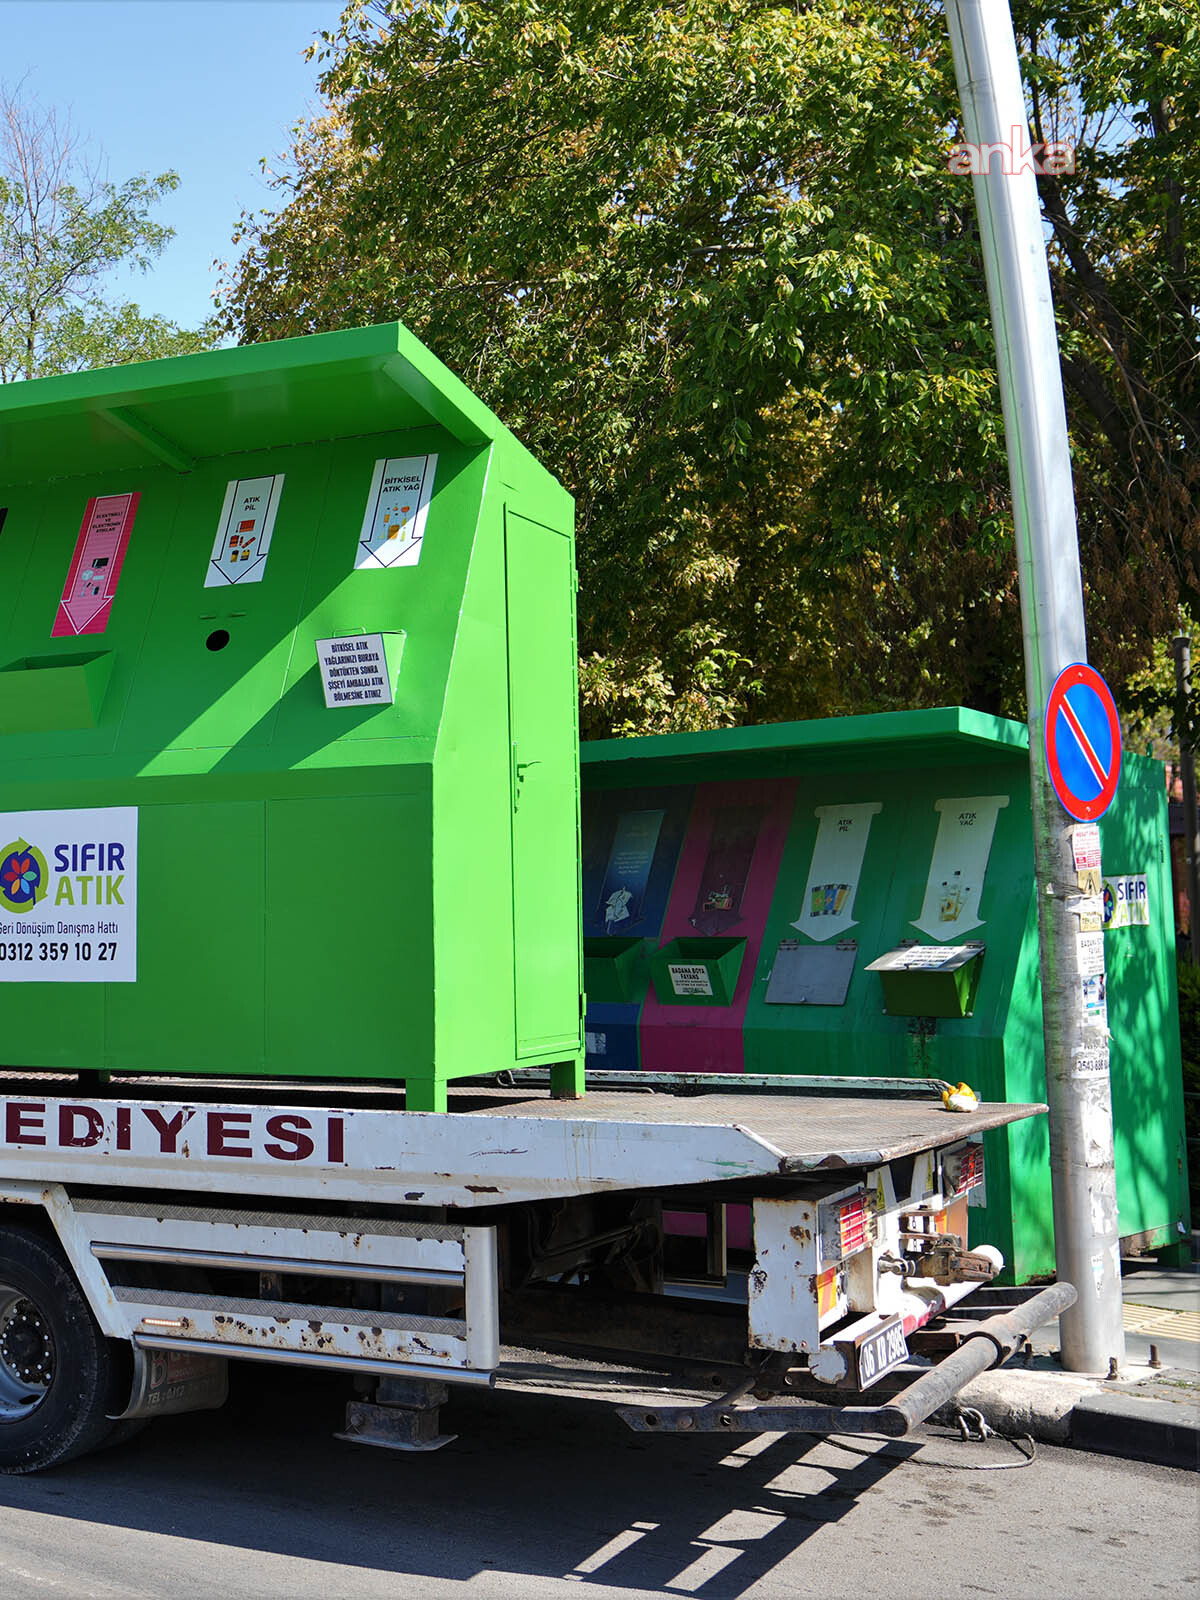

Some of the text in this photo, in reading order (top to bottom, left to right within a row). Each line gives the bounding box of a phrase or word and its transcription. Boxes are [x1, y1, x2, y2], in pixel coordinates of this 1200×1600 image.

[385, 475, 421, 484] BİTKİSEL
[383, 483, 420, 493] ATIK YAĞ
[244, 496, 261, 504] ATIK
[331, 641, 368, 653] BİTKİSEL ATIK
[357, 652, 380, 663] BURAYA
[360, 665, 378, 675] SONRA
[371, 677, 384, 686] ATIK
[364, 689, 381, 699] ATINIZ
[958, 812, 977, 820] ATIK
[54, 842, 125, 872] SIFIR
[54, 875, 125, 906] ATIK
[1117, 880, 1146, 900] SIFIR
[1120, 902, 1147, 924] ATIK
[16, 921, 55, 937] Dönüşüm
[57, 921, 95, 937] Danışma
[97, 921, 118, 934] Hattı
[39, 942, 69, 961] 359
[75, 942, 91, 961] 10
[98, 942, 117, 961] 27
